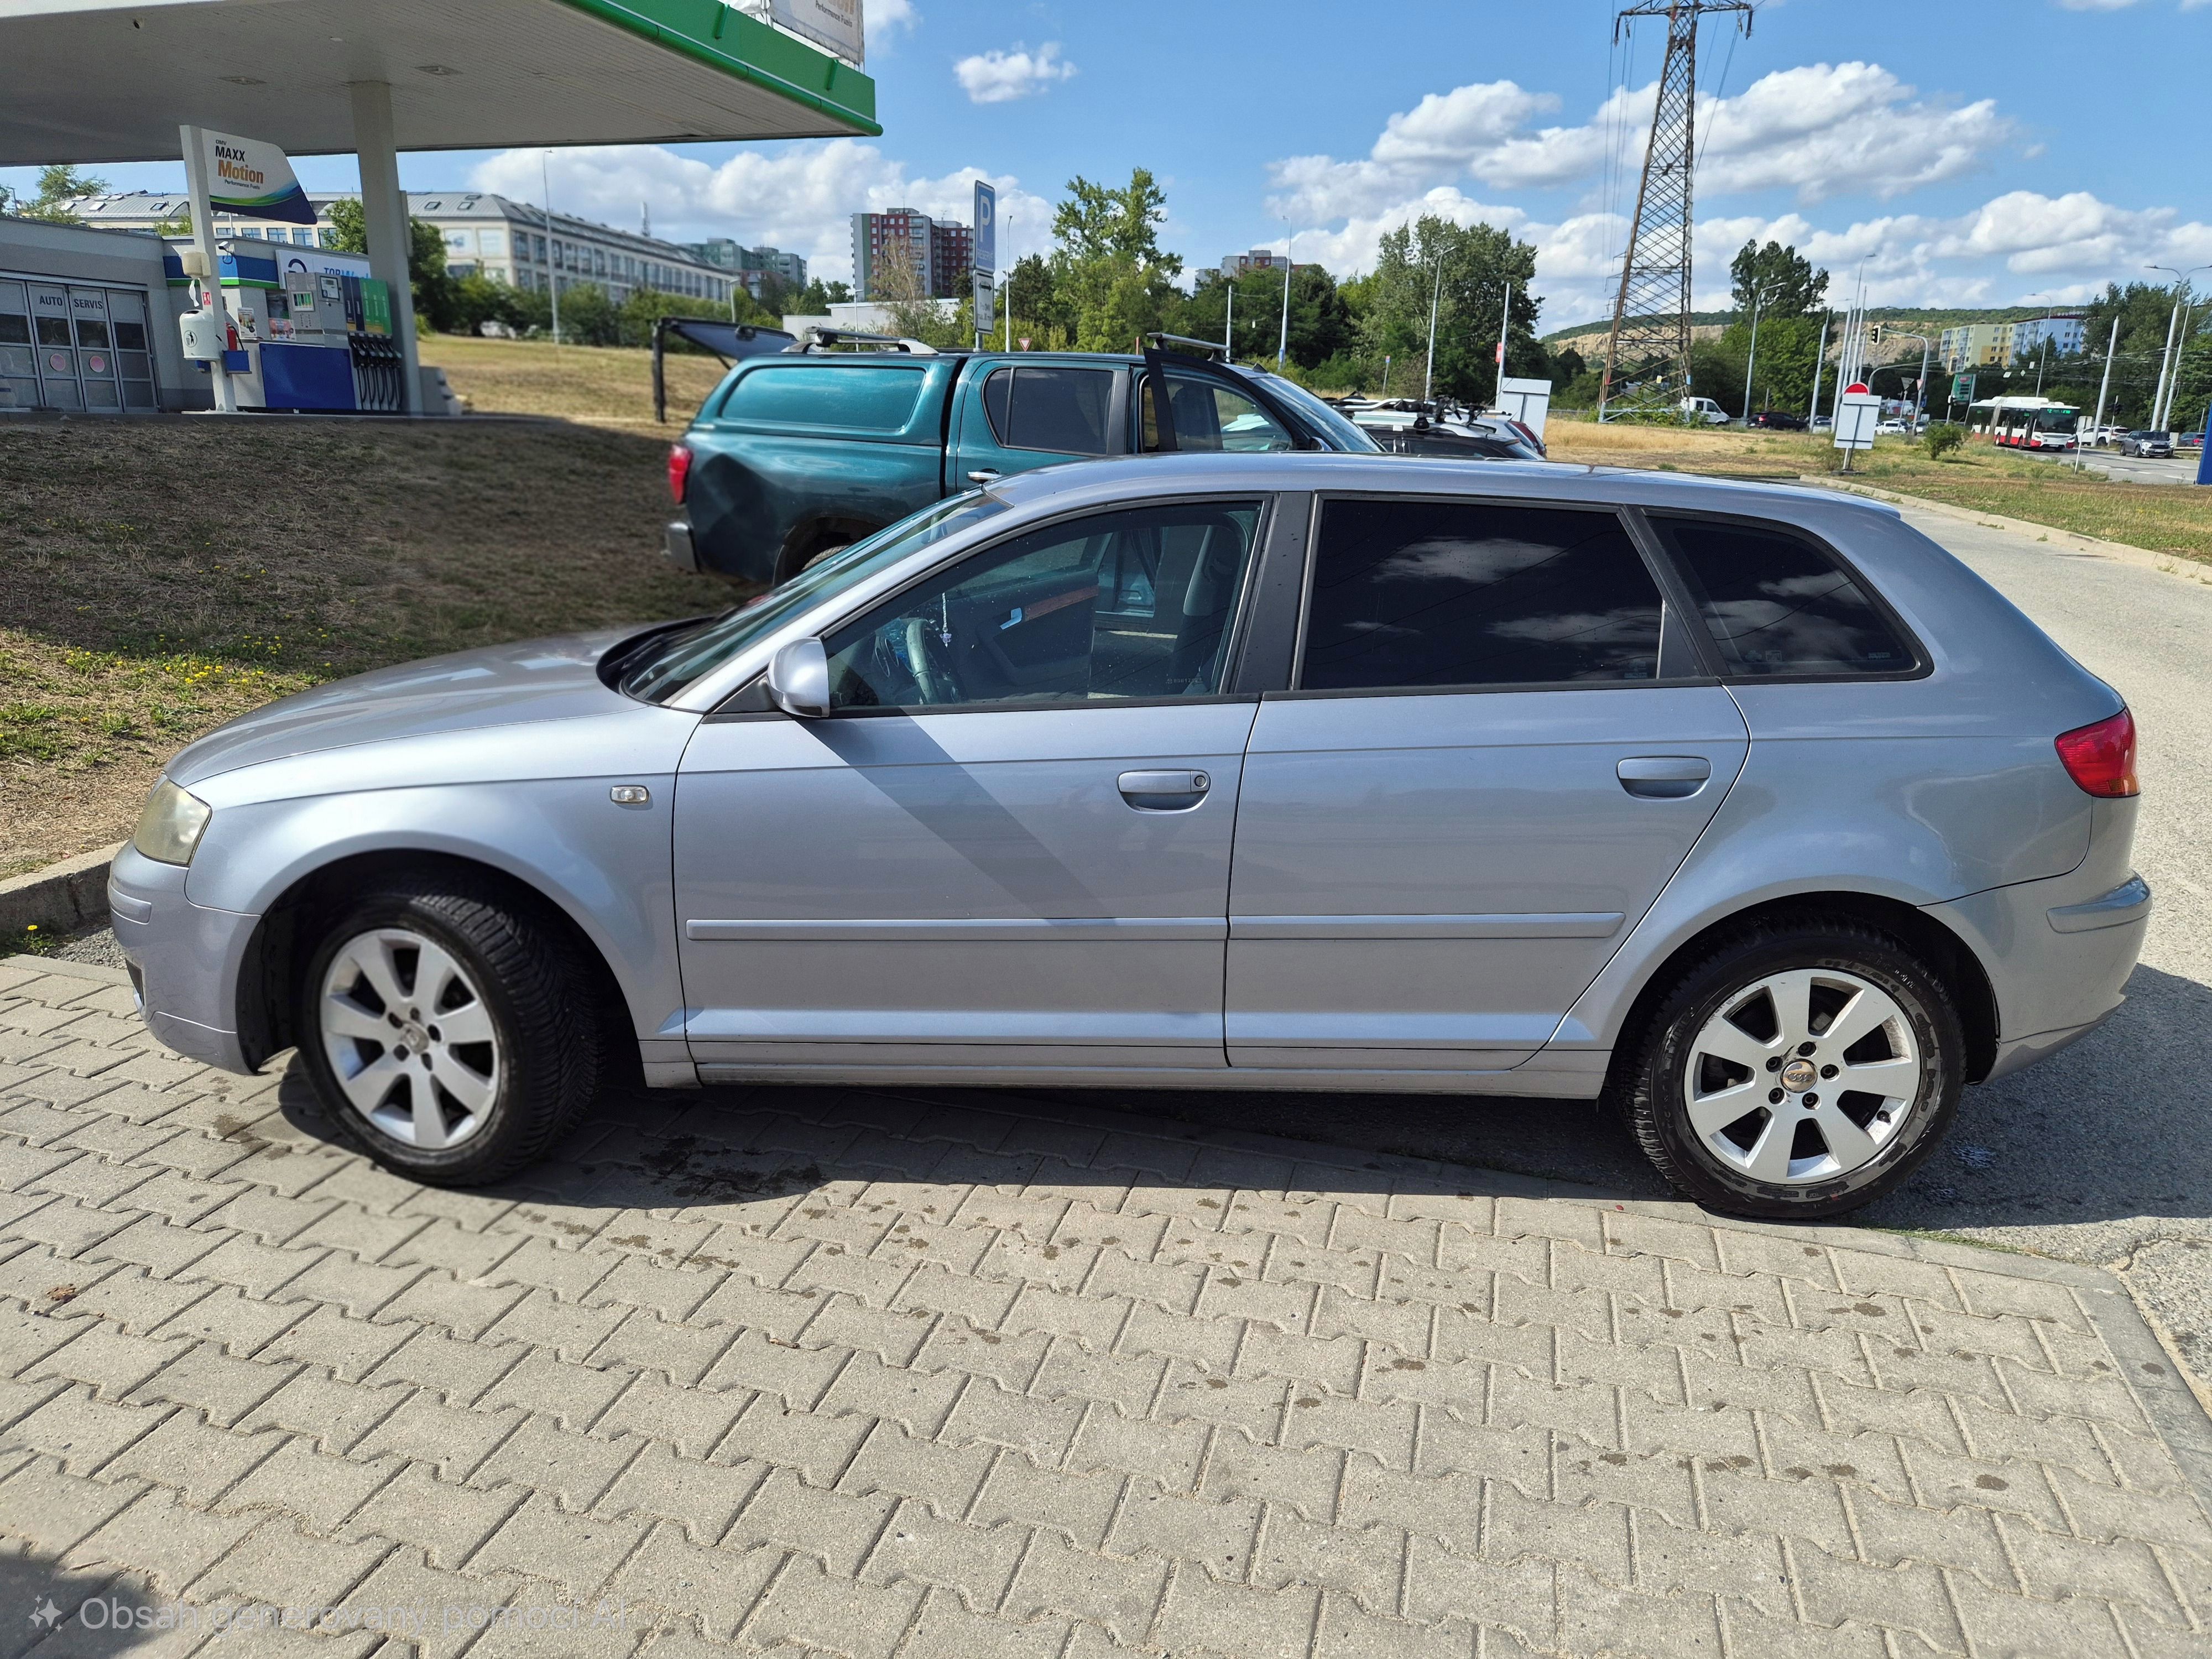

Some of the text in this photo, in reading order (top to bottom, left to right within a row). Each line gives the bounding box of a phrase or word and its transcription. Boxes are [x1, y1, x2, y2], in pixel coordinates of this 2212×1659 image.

[216, 145, 245, 162] MAXX
[218, 159, 264, 184] Motion
[225, 179, 249, 188] Performance
[979, 195, 992, 242] P
[39, 295, 103, 310] AUTO SERVIS
